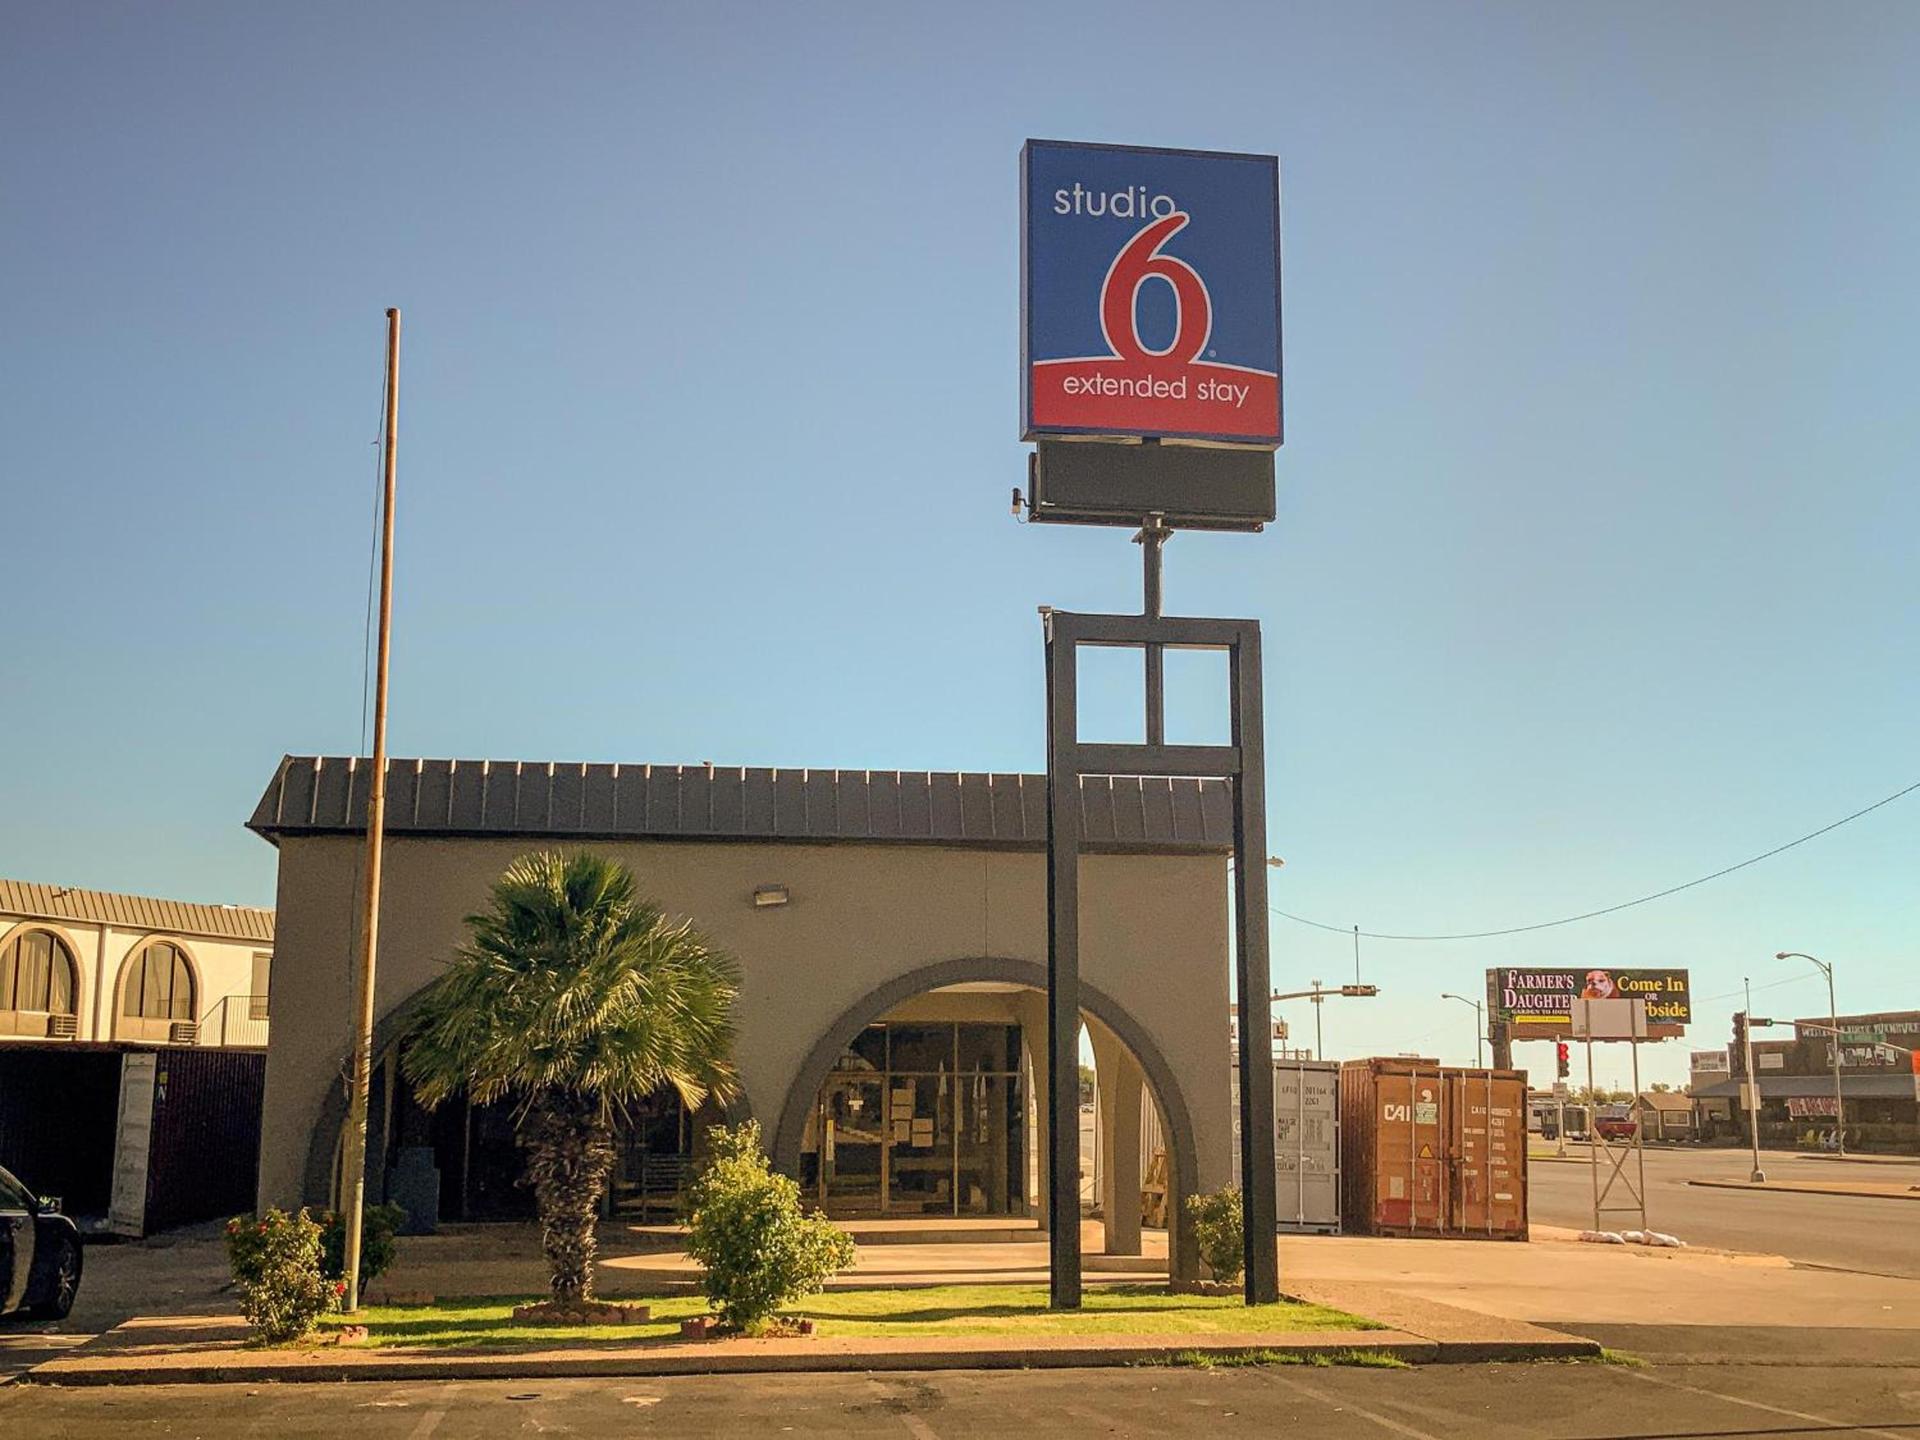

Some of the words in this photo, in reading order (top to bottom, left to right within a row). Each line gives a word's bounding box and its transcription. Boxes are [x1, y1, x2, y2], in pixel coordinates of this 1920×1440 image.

[1054, 182, 1176, 219] studio
[1099, 210, 1213, 363] 6
[1063, 374, 1187, 400] extended
[1197, 380, 1250, 408] stay
[1507, 969, 1574, 989] FARMER'S
[1617, 976, 1664, 992] Come
[1666, 976, 1684, 992] In
[1645, 992, 1658, 1001] OR
[1384, 1104, 1411, 1122] CAI
